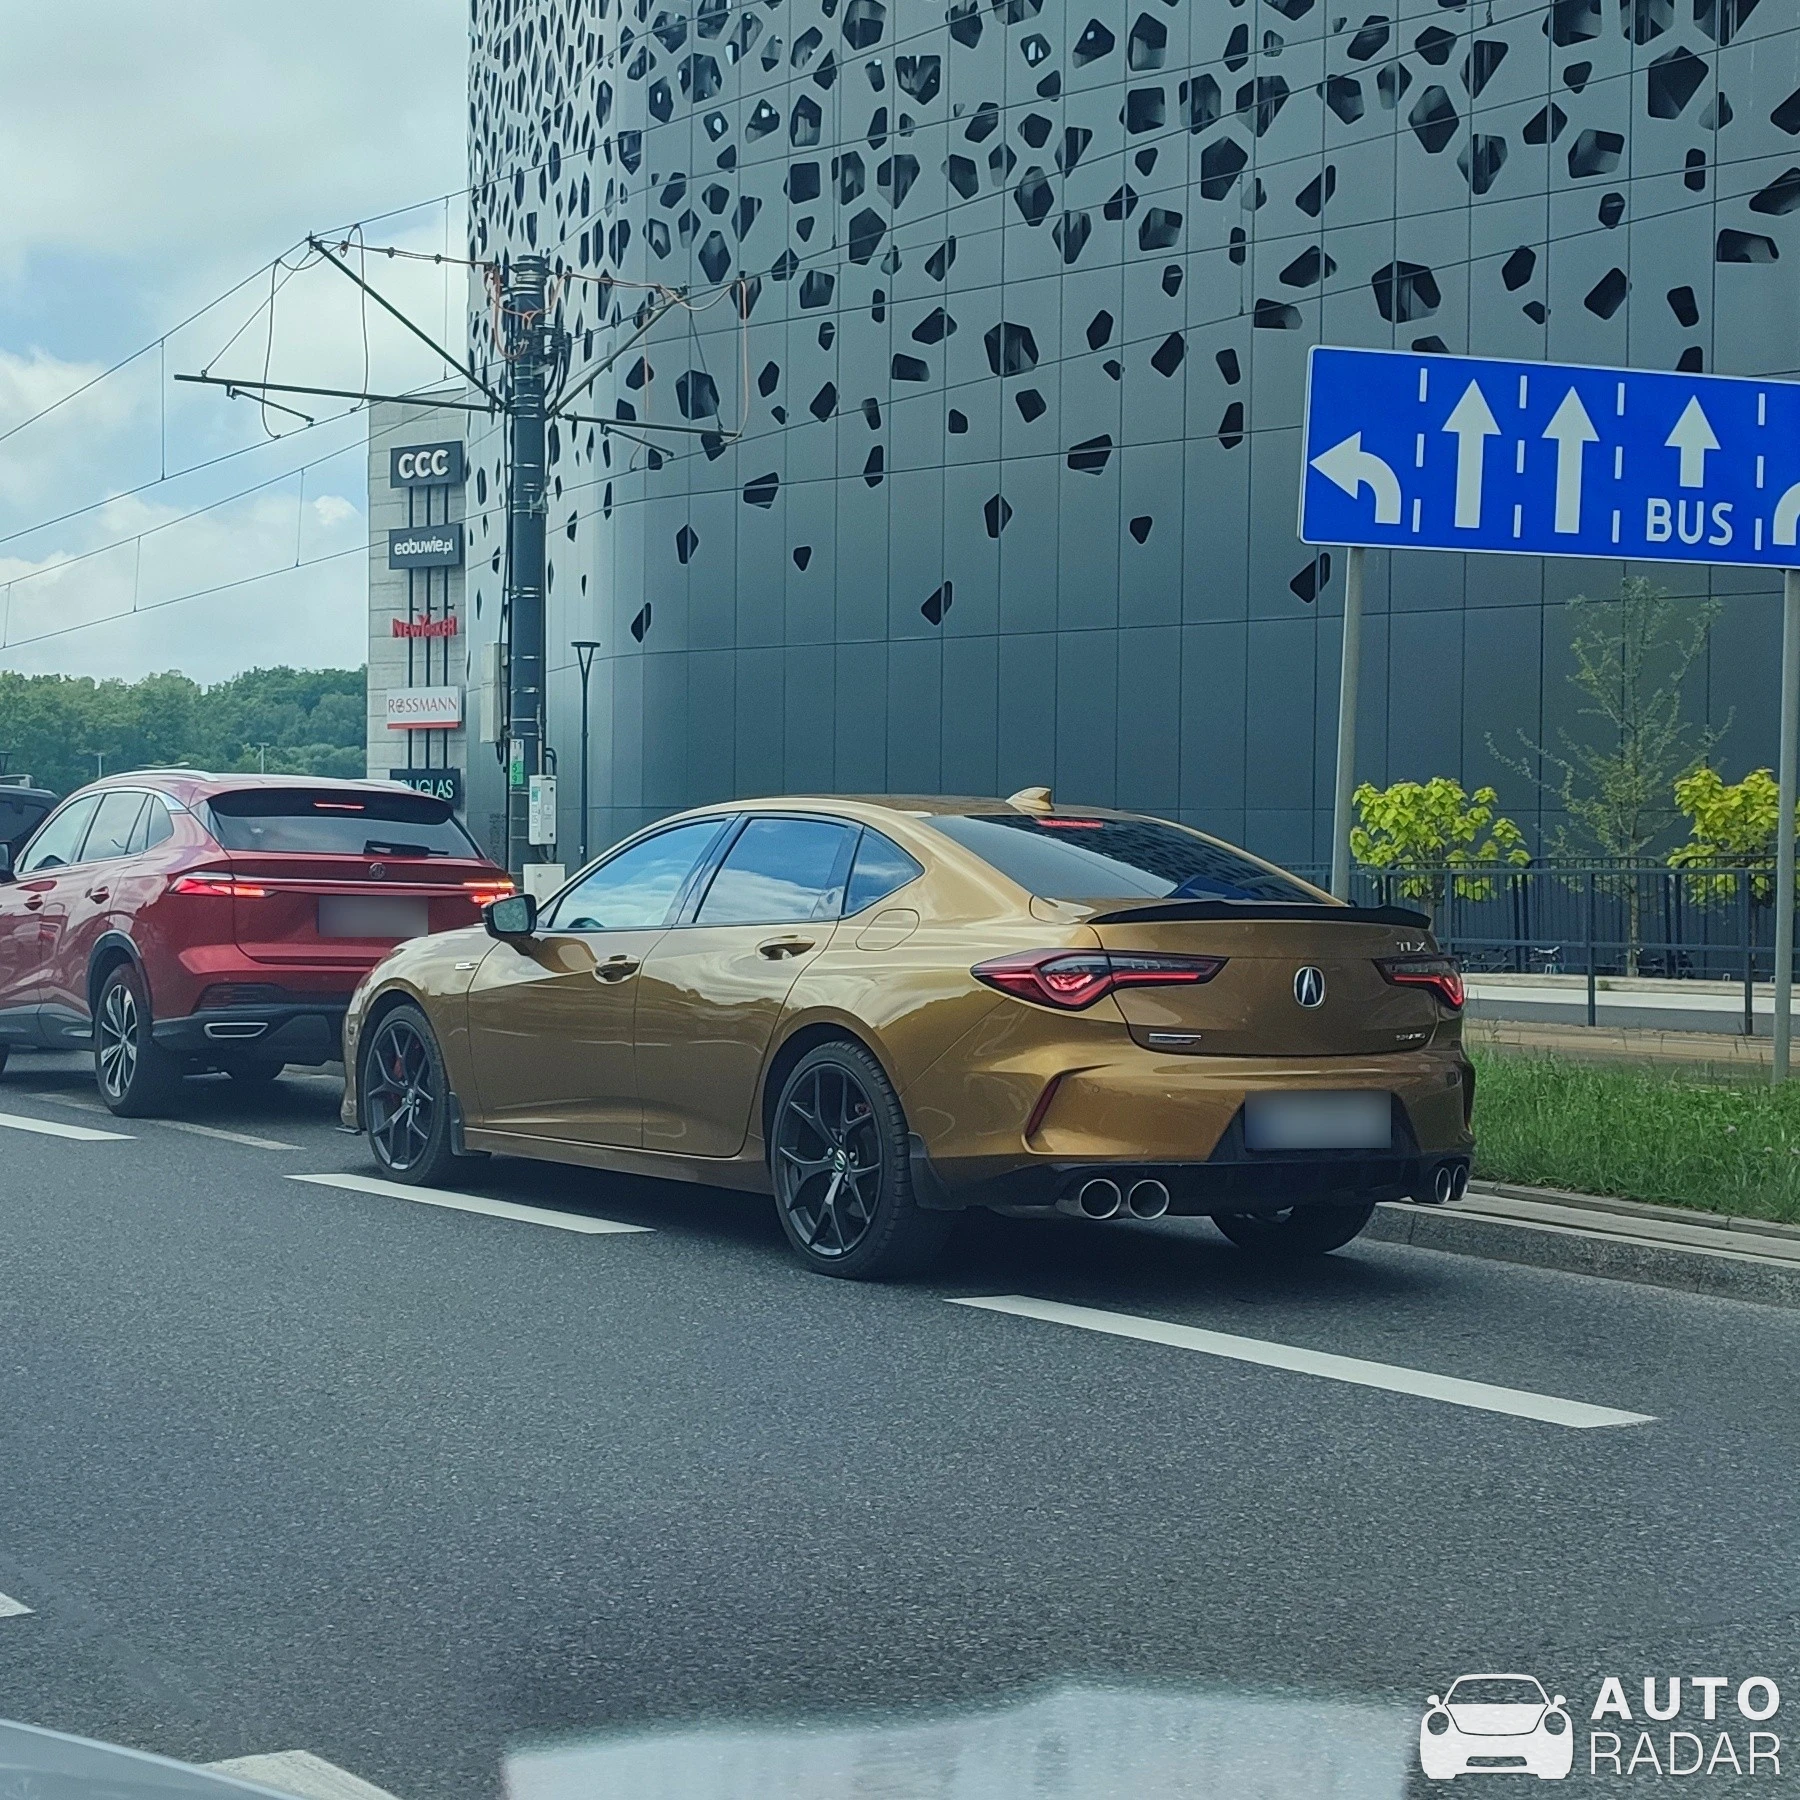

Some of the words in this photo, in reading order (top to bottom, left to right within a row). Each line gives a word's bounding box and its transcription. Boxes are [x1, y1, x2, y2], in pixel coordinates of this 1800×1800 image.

[399, 449, 449, 479] CCC
[1646, 497, 1734, 546] BUS
[394, 535, 454, 555] eobuwie.pl
[388, 696, 457, 713] ROSSMANN
[1396, 941, 1426, 952] TLX
